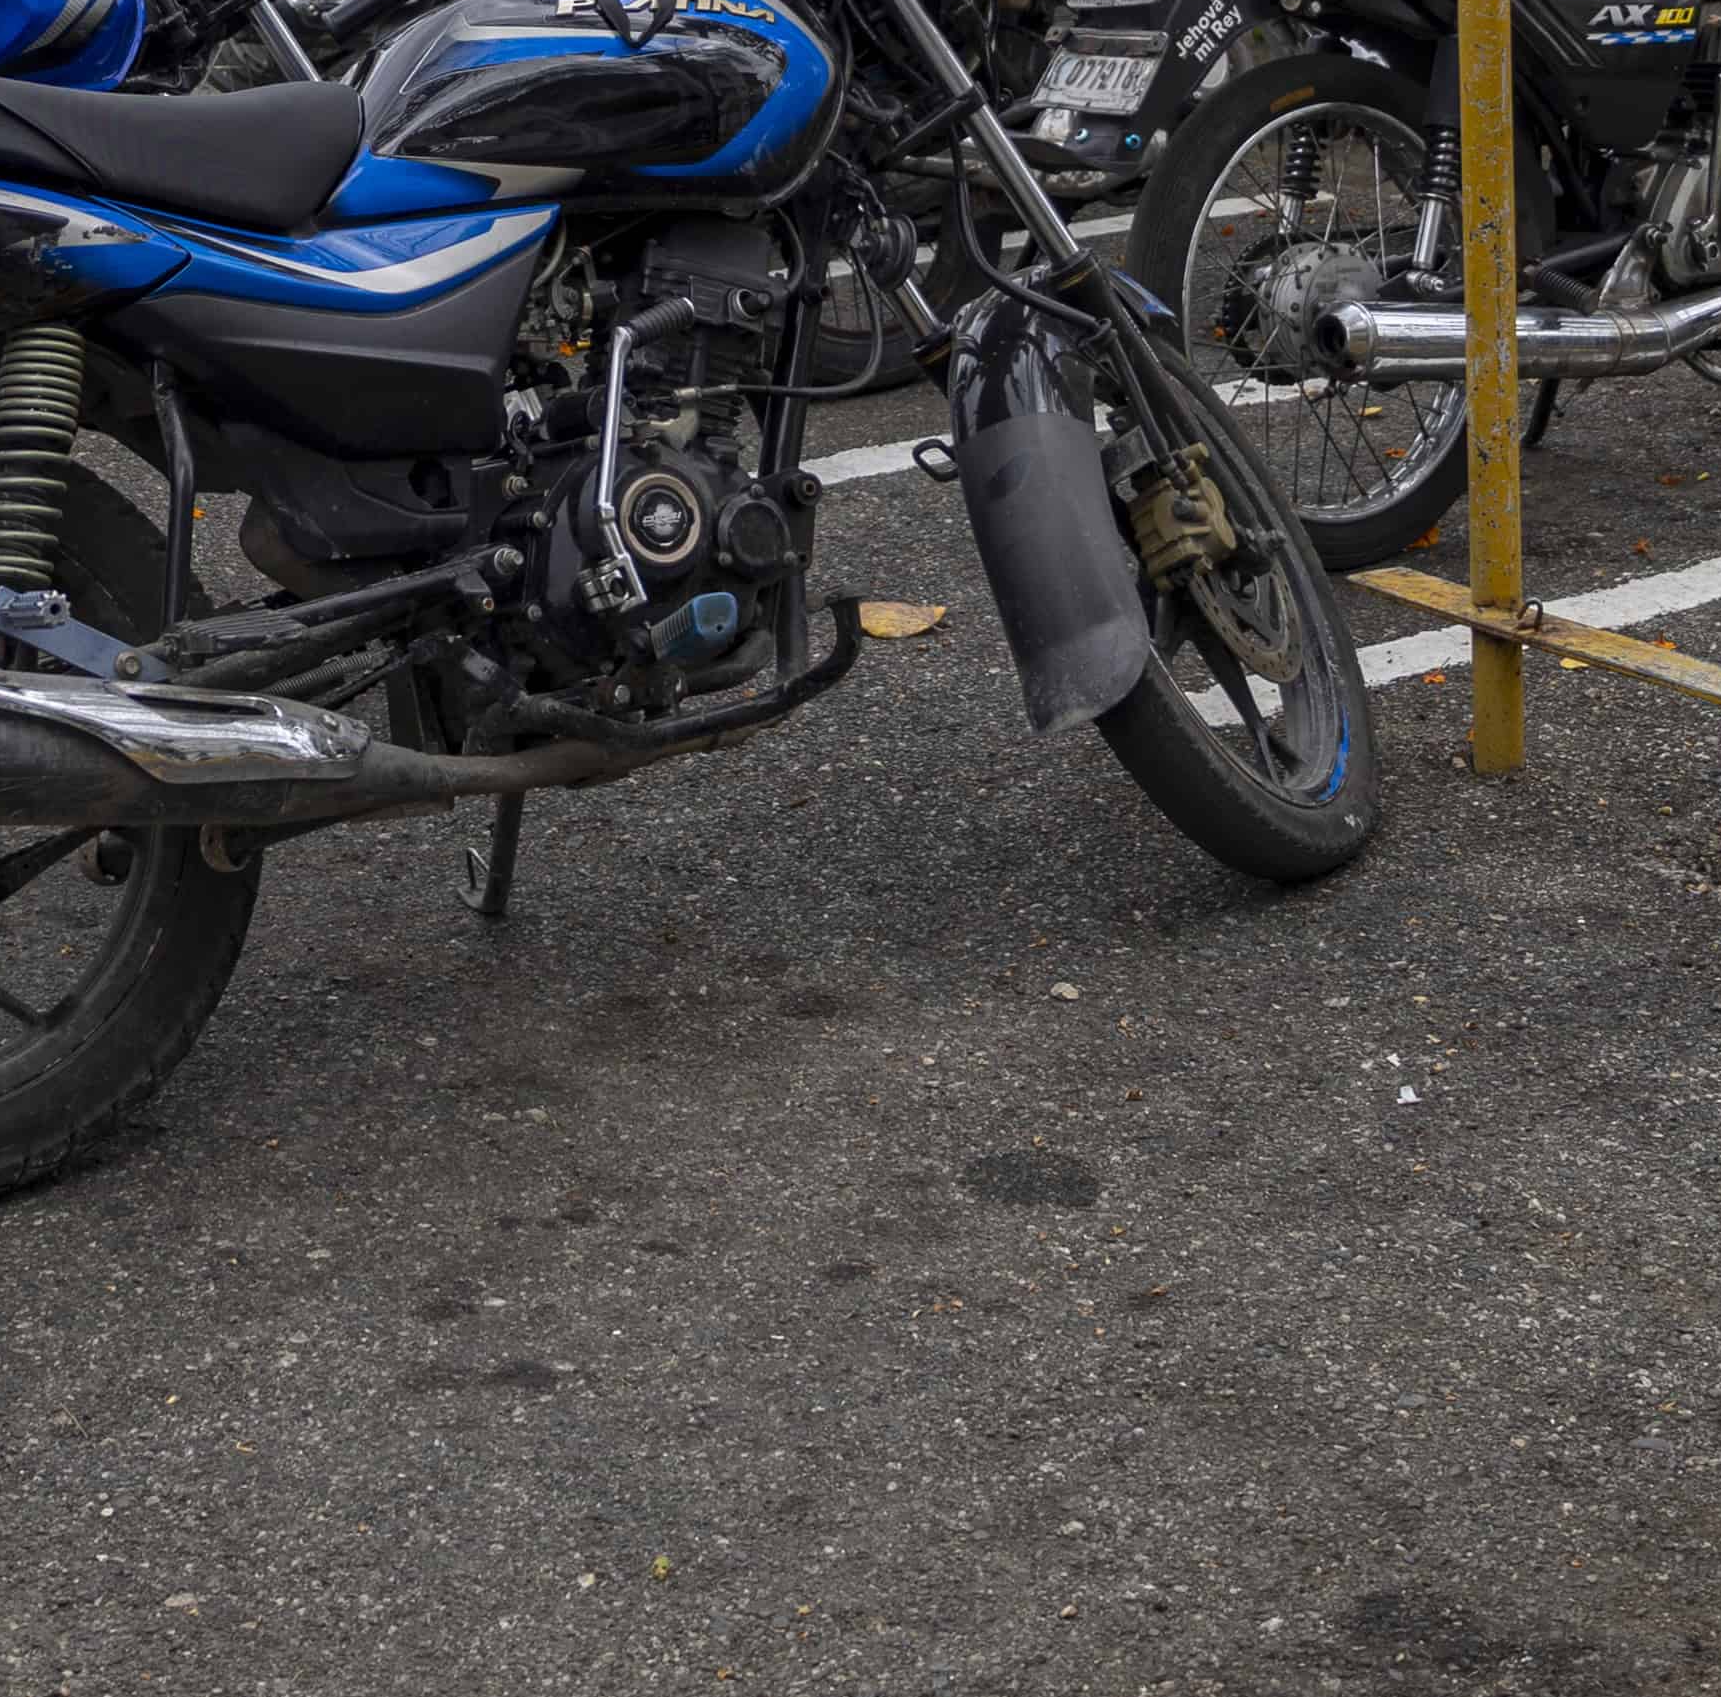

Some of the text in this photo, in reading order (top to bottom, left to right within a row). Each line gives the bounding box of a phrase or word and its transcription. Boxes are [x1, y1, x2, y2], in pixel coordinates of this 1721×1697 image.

[1193, 4, 1243, 63] mi Rey
[1586, 4, 1696, 26] AX 100
